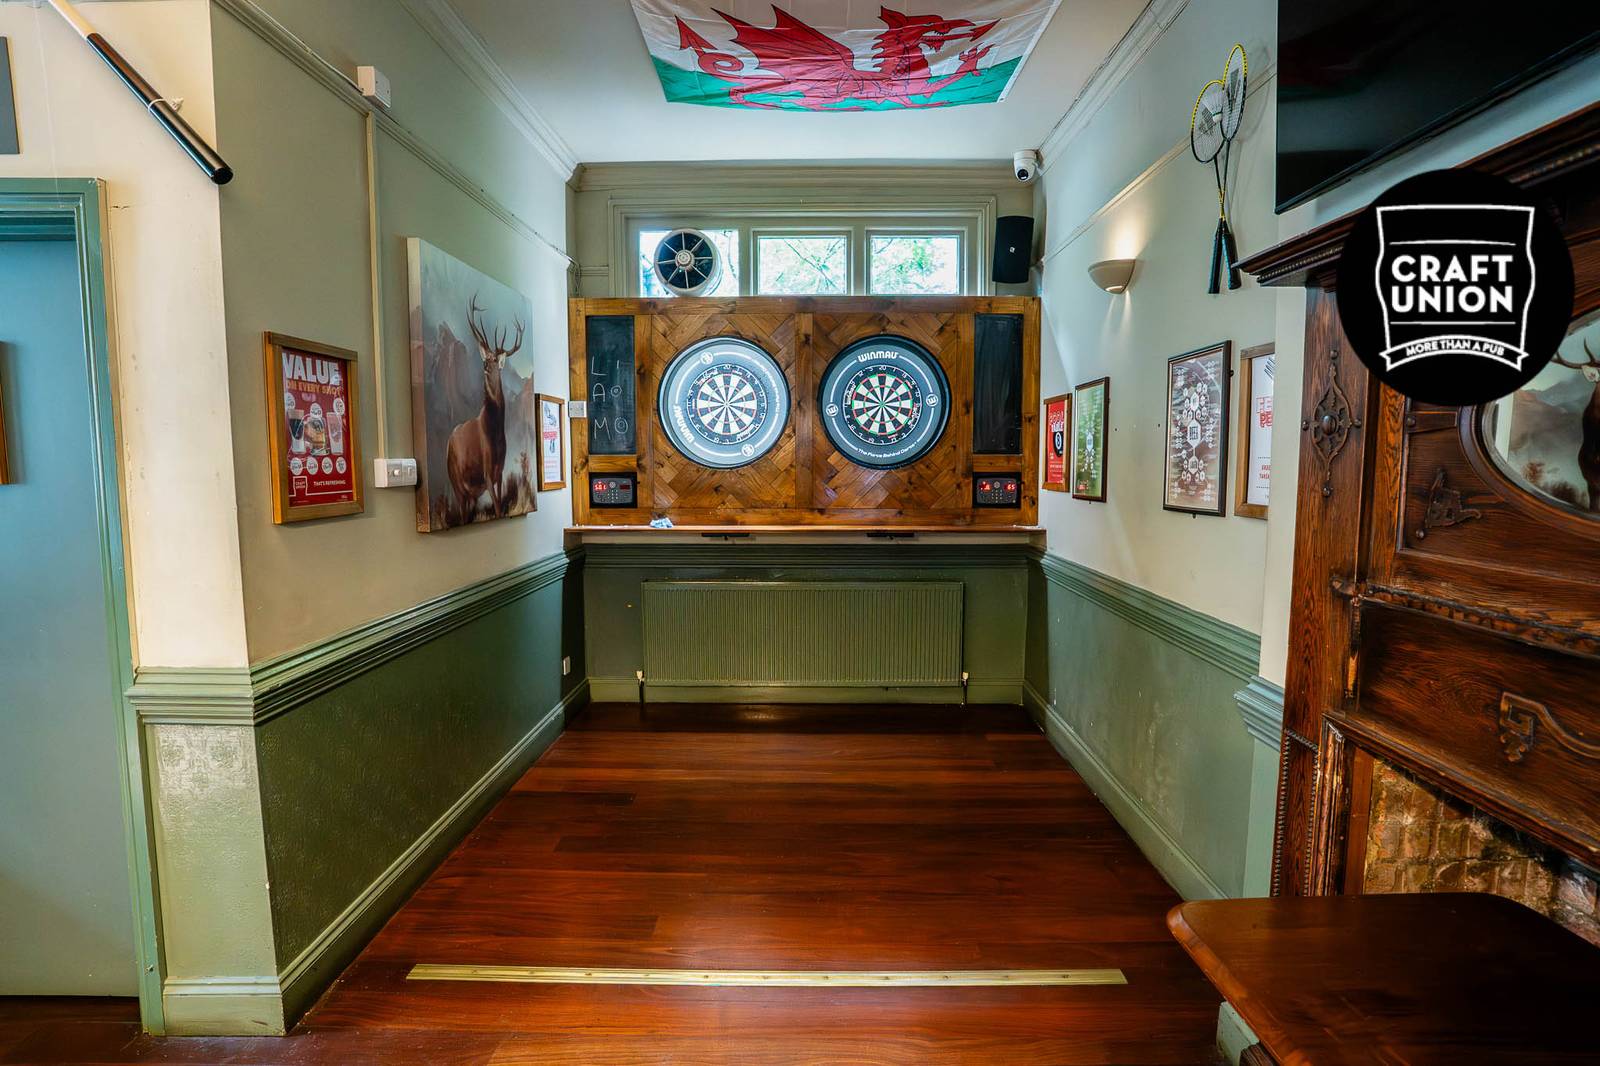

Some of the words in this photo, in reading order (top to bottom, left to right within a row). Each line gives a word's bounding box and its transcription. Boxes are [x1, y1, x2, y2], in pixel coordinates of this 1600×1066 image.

[858, 351, 899, 362] WINMAU
[282, 352, 341, 386] VALUE
[288, 380, 297, 390] ON
[298, 381, 320, 393] EVERY
[322, 385, 341, 395] SHOT
[592, 382, 605, 402] A
[594, 416, 611, 440] M
